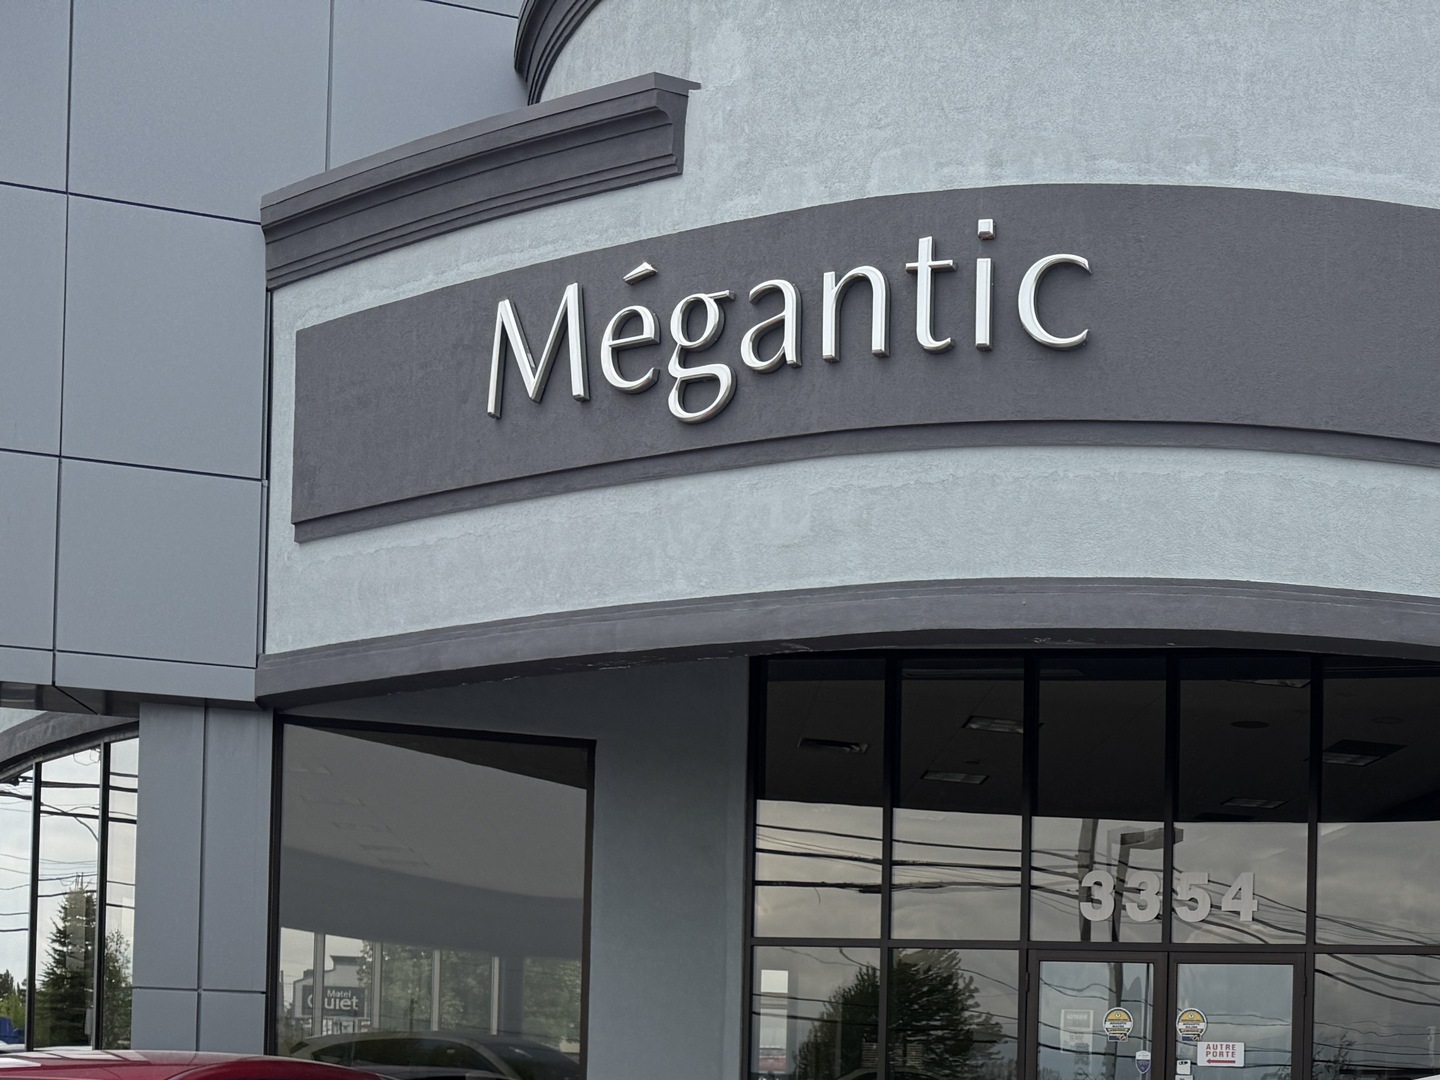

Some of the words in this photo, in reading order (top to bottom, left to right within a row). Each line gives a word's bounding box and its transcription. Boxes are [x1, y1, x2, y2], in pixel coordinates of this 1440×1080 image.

[487, 218, 1092, 423] Mégantic
[1080, 870, 1258, 922] 3354
[307, 994, 359, 1011] uiet
